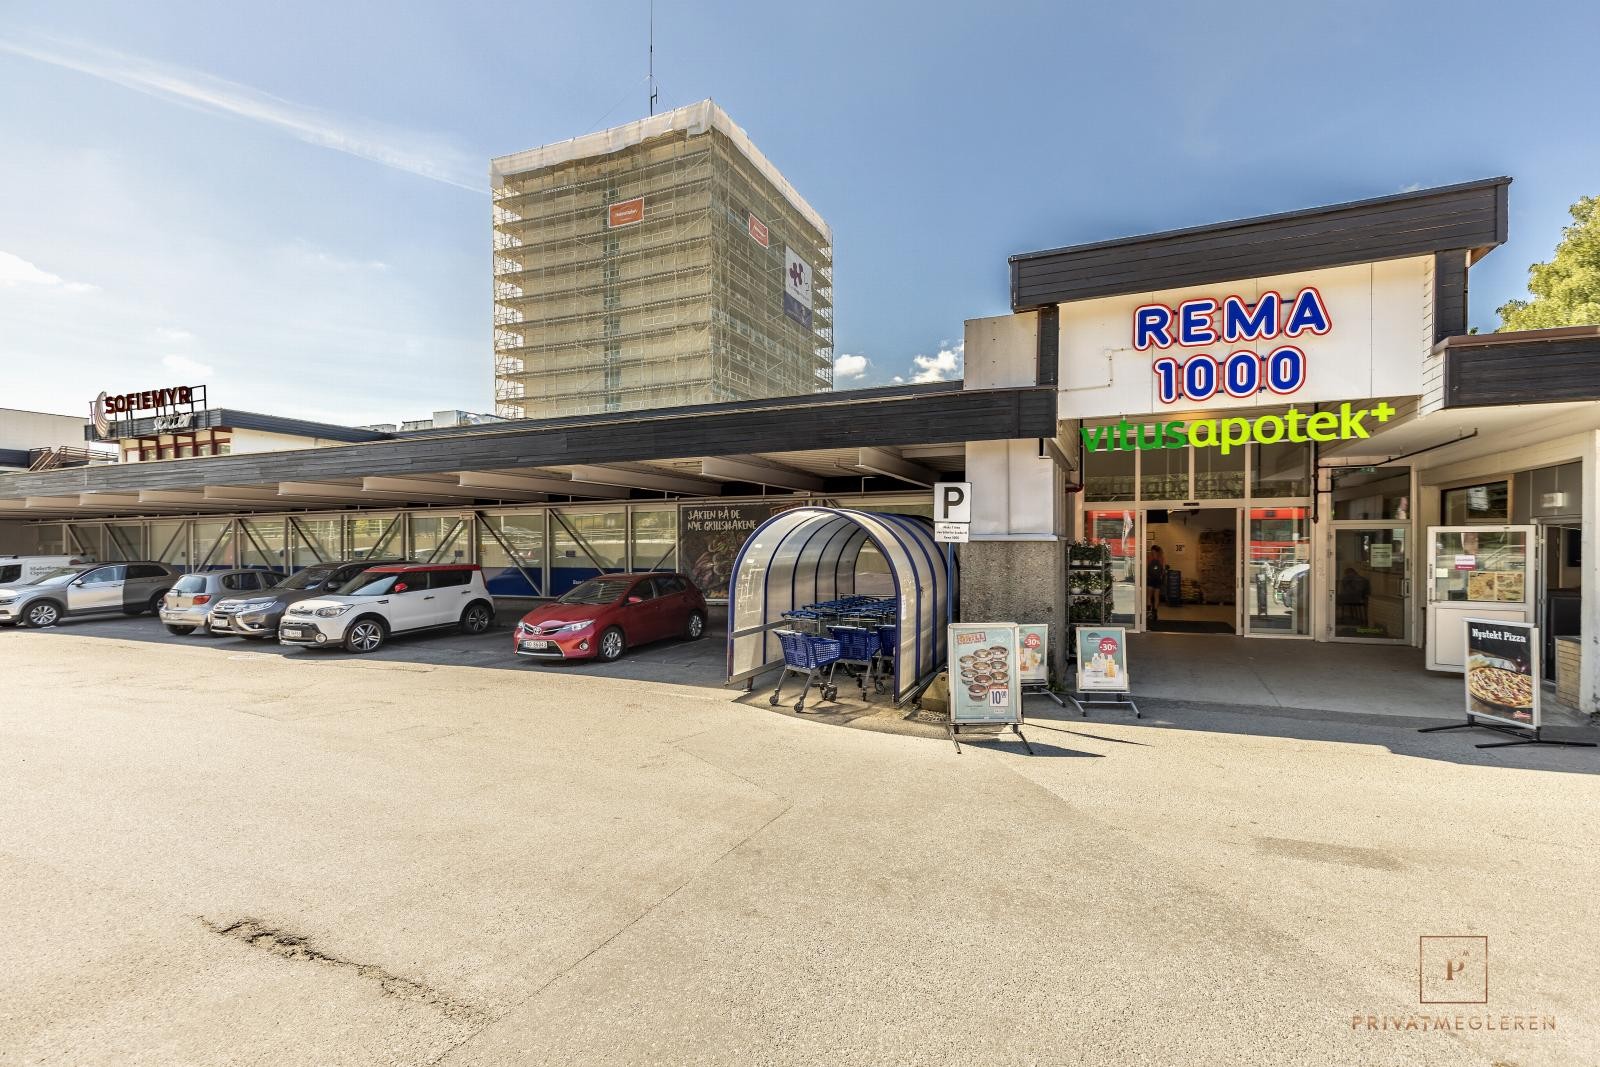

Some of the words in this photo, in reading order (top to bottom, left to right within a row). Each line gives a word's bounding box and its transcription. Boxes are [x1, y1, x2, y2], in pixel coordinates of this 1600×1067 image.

[1133, 287, 1332, 351] REMA
[1153, 345, 1306, 404] 1000
[105, 386, 190, 414] SOFIEMYR
[687, 509, 716, 520] JAKTEN
[718, 507, 730, 519] PÅ
[731, 509, 741, 519] DE
[943, 486, 965, 519] P
[687, 521, 702, 531] NYE
[703, 519, 757, 531] GRILLSMAKENE
[1472, 628, 1502, 640] Nystekt
[1503, 631, 1527, 643] Pizza
